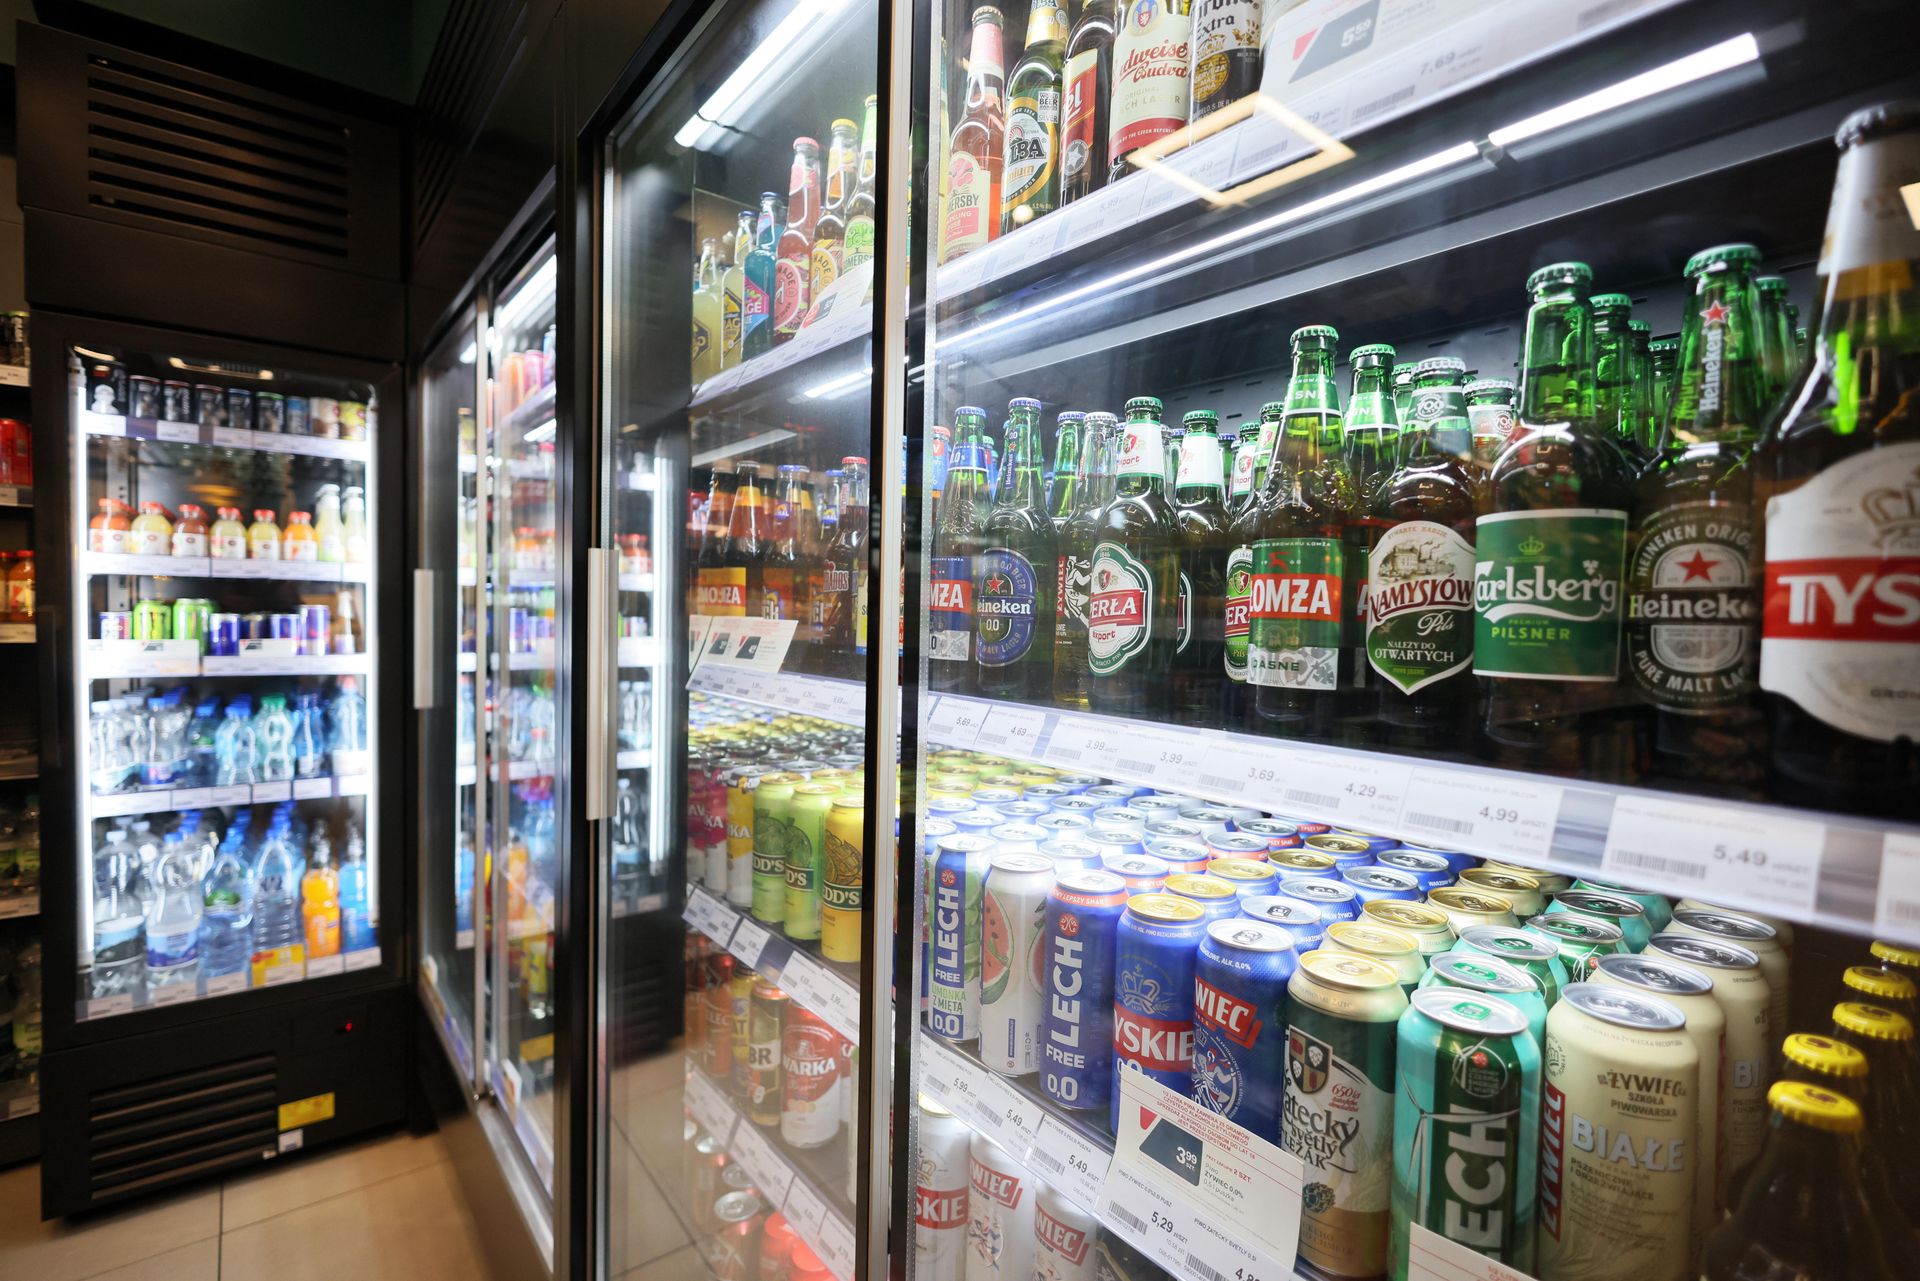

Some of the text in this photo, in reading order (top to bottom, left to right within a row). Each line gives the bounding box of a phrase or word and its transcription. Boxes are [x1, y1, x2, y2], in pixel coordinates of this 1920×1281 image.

[1699, 328, 1722, 411] Heineken
[1636, 524, 1697, 577] HEINEKEN
[1474, 560, 1618, 612] Carlsberg
[1370, 573, 1475, 622] NAMYSŁÓW
[1417, 611, 1455, 636] Pils
[1491, 626, 1571, 640] PILSNER
[1374, 648, 1454, 662] OTWARTYCH
[1635, 650, 1664, 683] PURE
[1666, 675, 1713, 693] MALT
[1010, 726, 1027, 737] 4,69
[1086, 739, 1105, 752] 3,99
[1160, 751, 1183, 765] 3,99
[1248, 768, 1275, 782] 3,69
[1345, 781, 1377, 799] 4,29
[1479, 805, 1518, 824] 4,99
[1711, 844, 1768, 867] 5,49
[1063, 894, 1085, 904] LEPSZY
[937, 887, 960, 969] LECH
[1221, 957, 1234, 967] ALK.
[935, 969, 961, 983] FREE
[931, 984, 967, 1001] LIMONKA
[1051, 935, 1083, 1047] LECH
[933, 996, 939, 1006] Z
[934, 1014, 960, 1035] 0,0
[1046, 1043, 1085, 1070] FREE
[953, 1077, 968, 1094] 5,99
[1047, 1073, 1079, 1102] 0,0
[1610, 1099, 1678, 1117] PIWOWARSKA
[1628, 1092, 1665, 1106] SZKOŁA
[1006, 1108, 1023, 1127] 5,49
[1163, 1096, 1249, 1146] CZYSTEGO ALKOHOLU ETYLOWEGO
[1178, 1119, 1189, 1129] JEST
[1180, 1114, 1207, 1132] ALKOHOLU
[1207, 1128, 1230, 1145] OSOBOM
[1239, 1146, 1249, 1154] LAT
[1291, 1123, 1337, 1159] světlý
[1571, 1113, 1684, 1173] BIAŁE
[1068, 1154, 1088, 1174] 5,49
[1570, 1157, 1631, 1186] PSZENICZNE
[1215, 1187, 1235, 1202] puszka
[1151, 1211, 1174, 1233] 5,29
